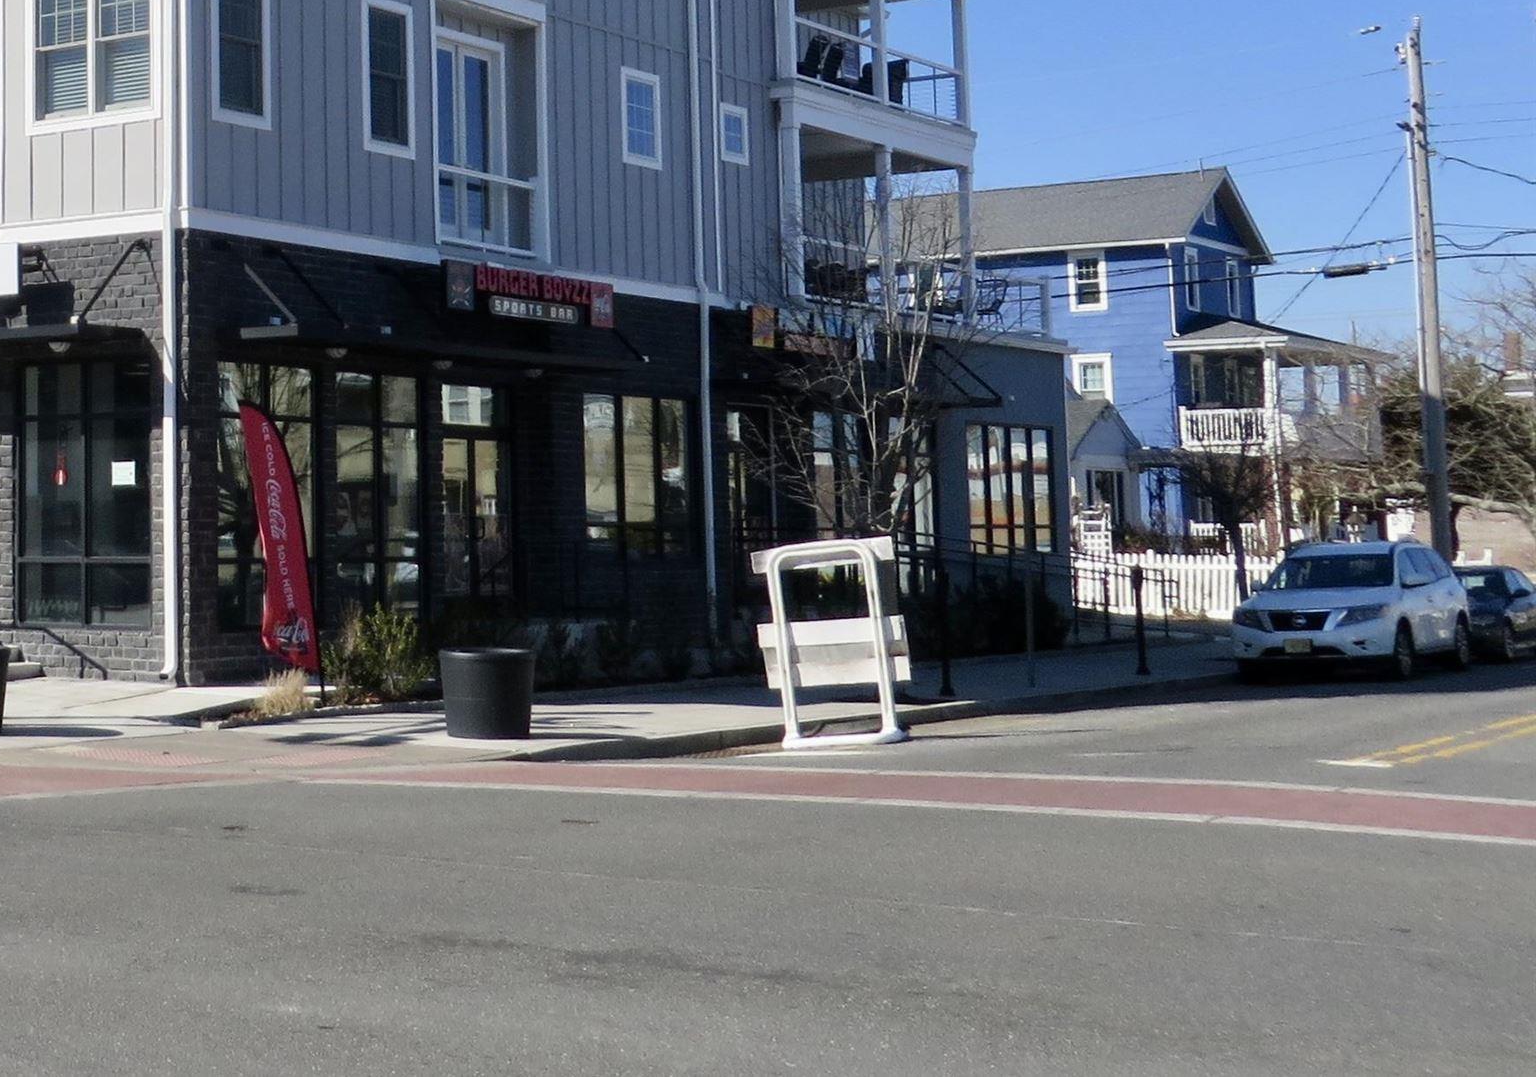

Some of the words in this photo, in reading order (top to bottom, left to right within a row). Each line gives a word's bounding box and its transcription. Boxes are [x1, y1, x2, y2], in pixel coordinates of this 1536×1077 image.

[476, 263, 539, 298] BURGER
[543, 274, 591, 304] BOYZZ
[494, 300, 543, 316] SPORTS
[550, 306, 574, 320] BAR
[265, 444, 276, 476] COLD
[277, 544, 289, 575] SOLD
